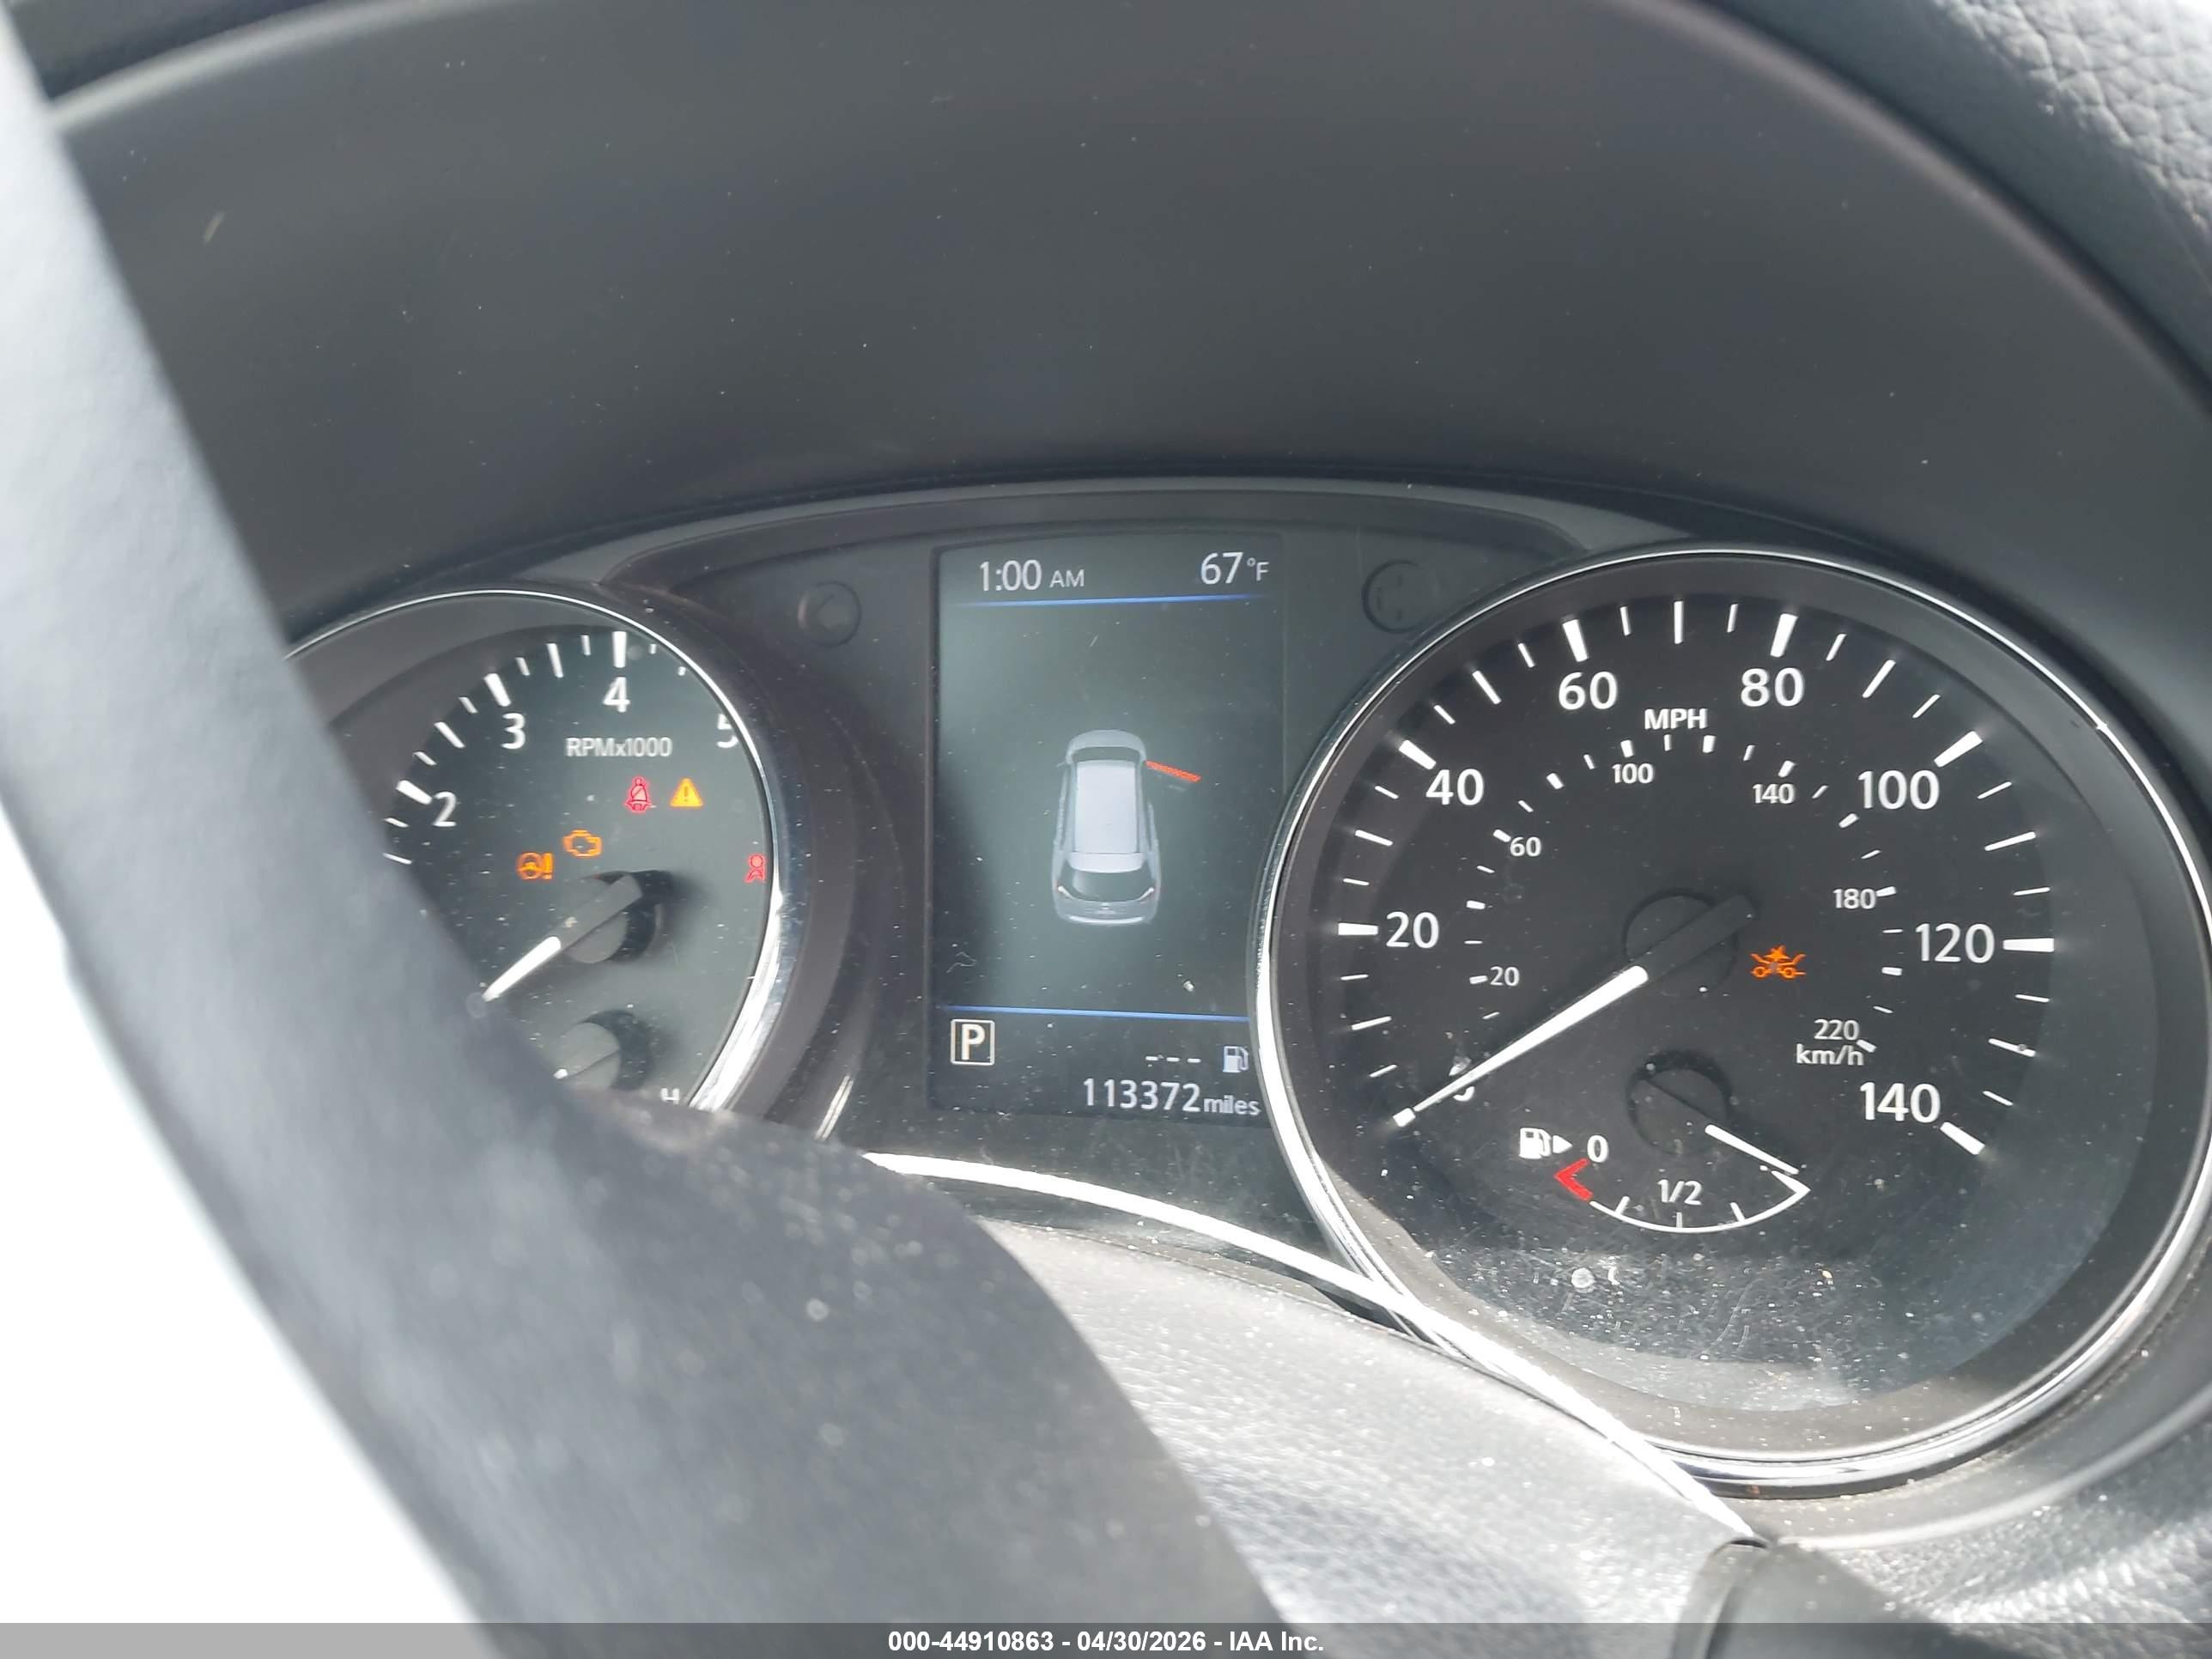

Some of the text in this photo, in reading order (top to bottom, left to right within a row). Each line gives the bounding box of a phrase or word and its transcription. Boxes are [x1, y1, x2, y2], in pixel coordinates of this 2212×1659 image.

[980, 560, 1085, 591] 1:00 AM
[603, 677, 630, 713] 4
[1558, 671, 1618, 710] 60
[1740, 668, 1804, 707] 80
[501, 713, 526, 750] 3
[716, 713, 739, 749] 5
[1644, 708, 1708, 730] MPH
[565, 737, 673, 757] RPMx1000
[1425, 769, 1485, 805] 40
[1613, 763, 1654, 785] 100
[1857, 769, 1940, 810] 100
[432, 791, 458, 827] 2
[1753, 783, 1796, 805] 140
[1510, 836, 1541, 857] 60
[1832, 888, 1876, 910] 180
[1386, 911, 1439, 949] 20
[1915, 922, 1995, 963] 120
[1490, 966, 1520, 988] 20
[961, 1024, 986, 1060] P
[1814, 1018, 1859, 1041] 220
[1796, 1044, 1863, 1066] km/h
[1859, 1081, 1942, 1122] 140
[1586, 1134, 1610, 1163] 0
[1657, 1179, 1704, 1206] 1/2
